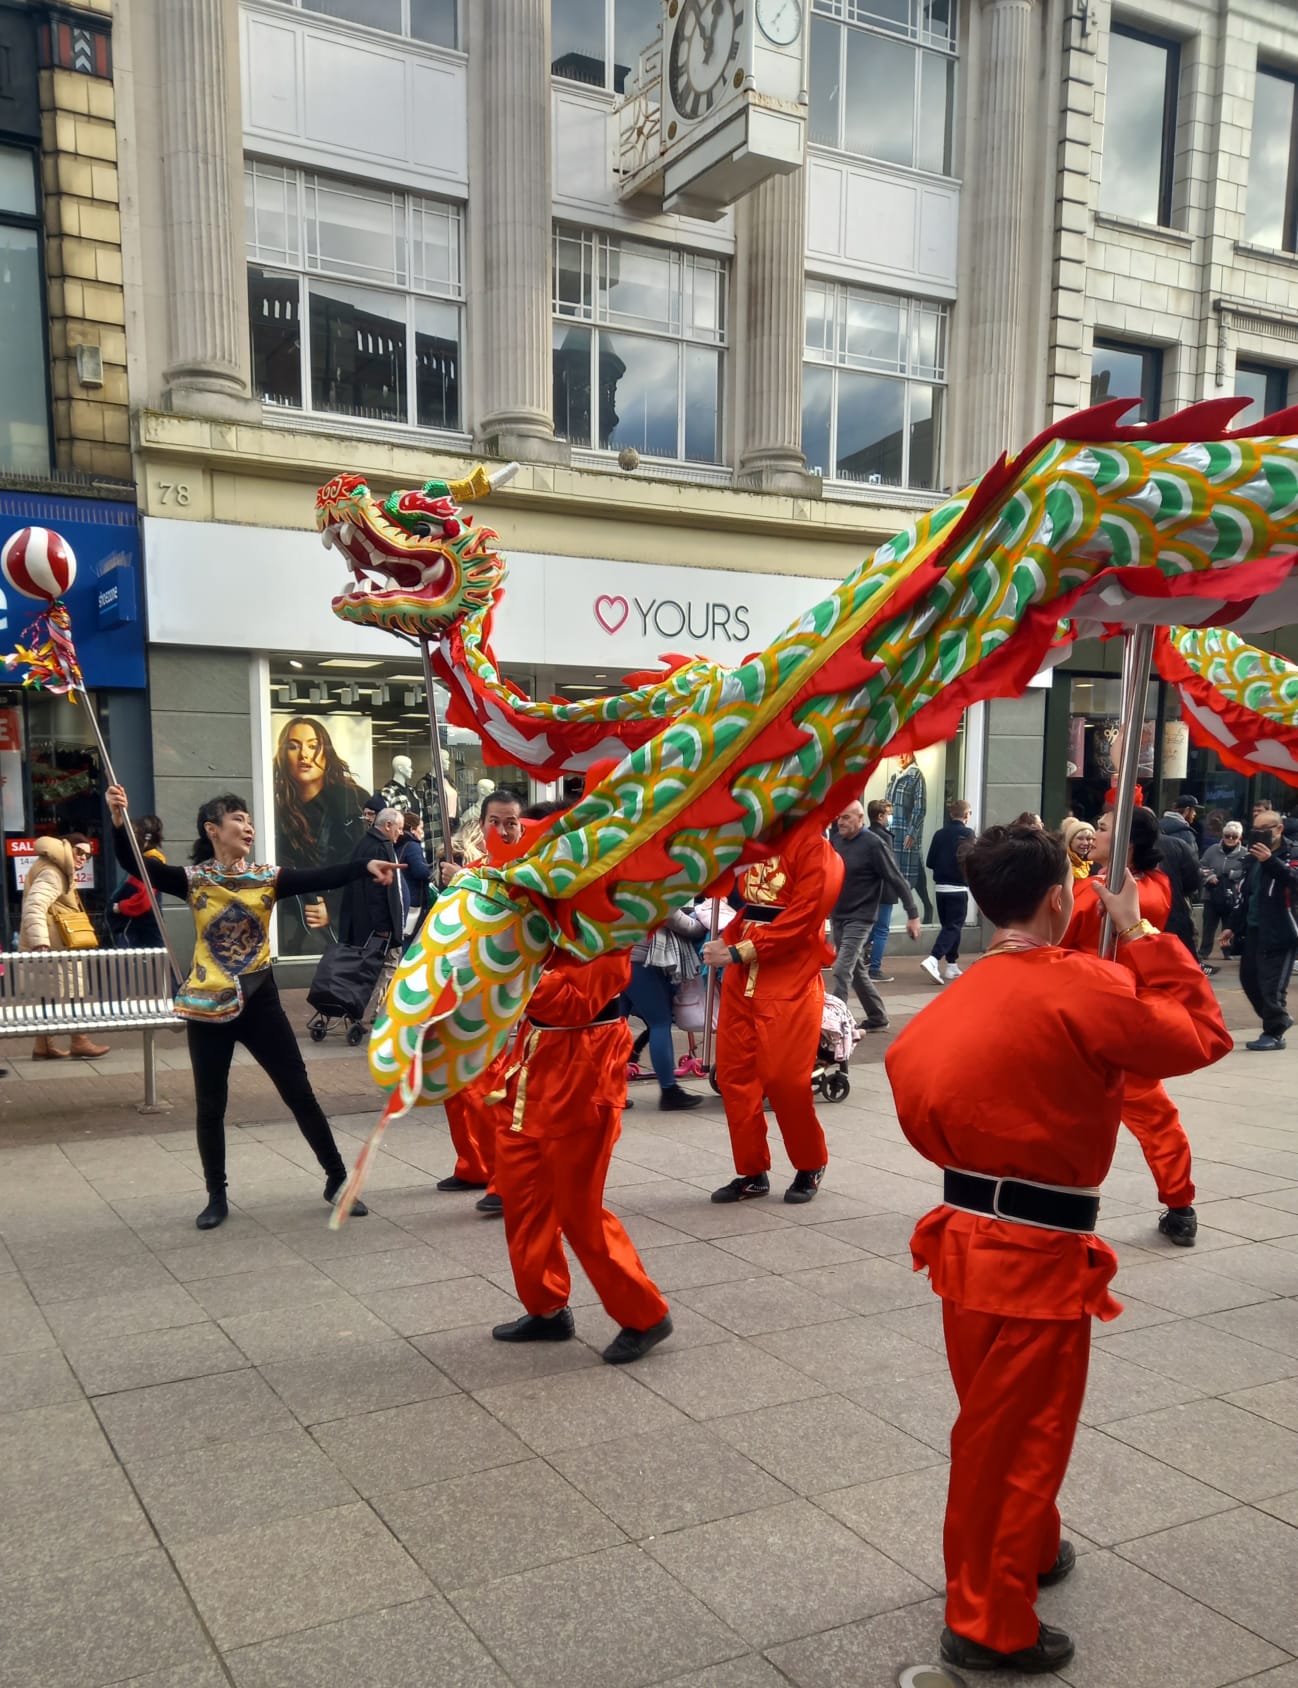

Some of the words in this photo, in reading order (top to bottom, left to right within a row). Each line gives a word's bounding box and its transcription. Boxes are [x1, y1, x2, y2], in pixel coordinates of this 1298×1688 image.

[158, 481, 190, 506] 78
[634, 597, 750, 641] YOURS
[11, 841, 35, 852] SAL
